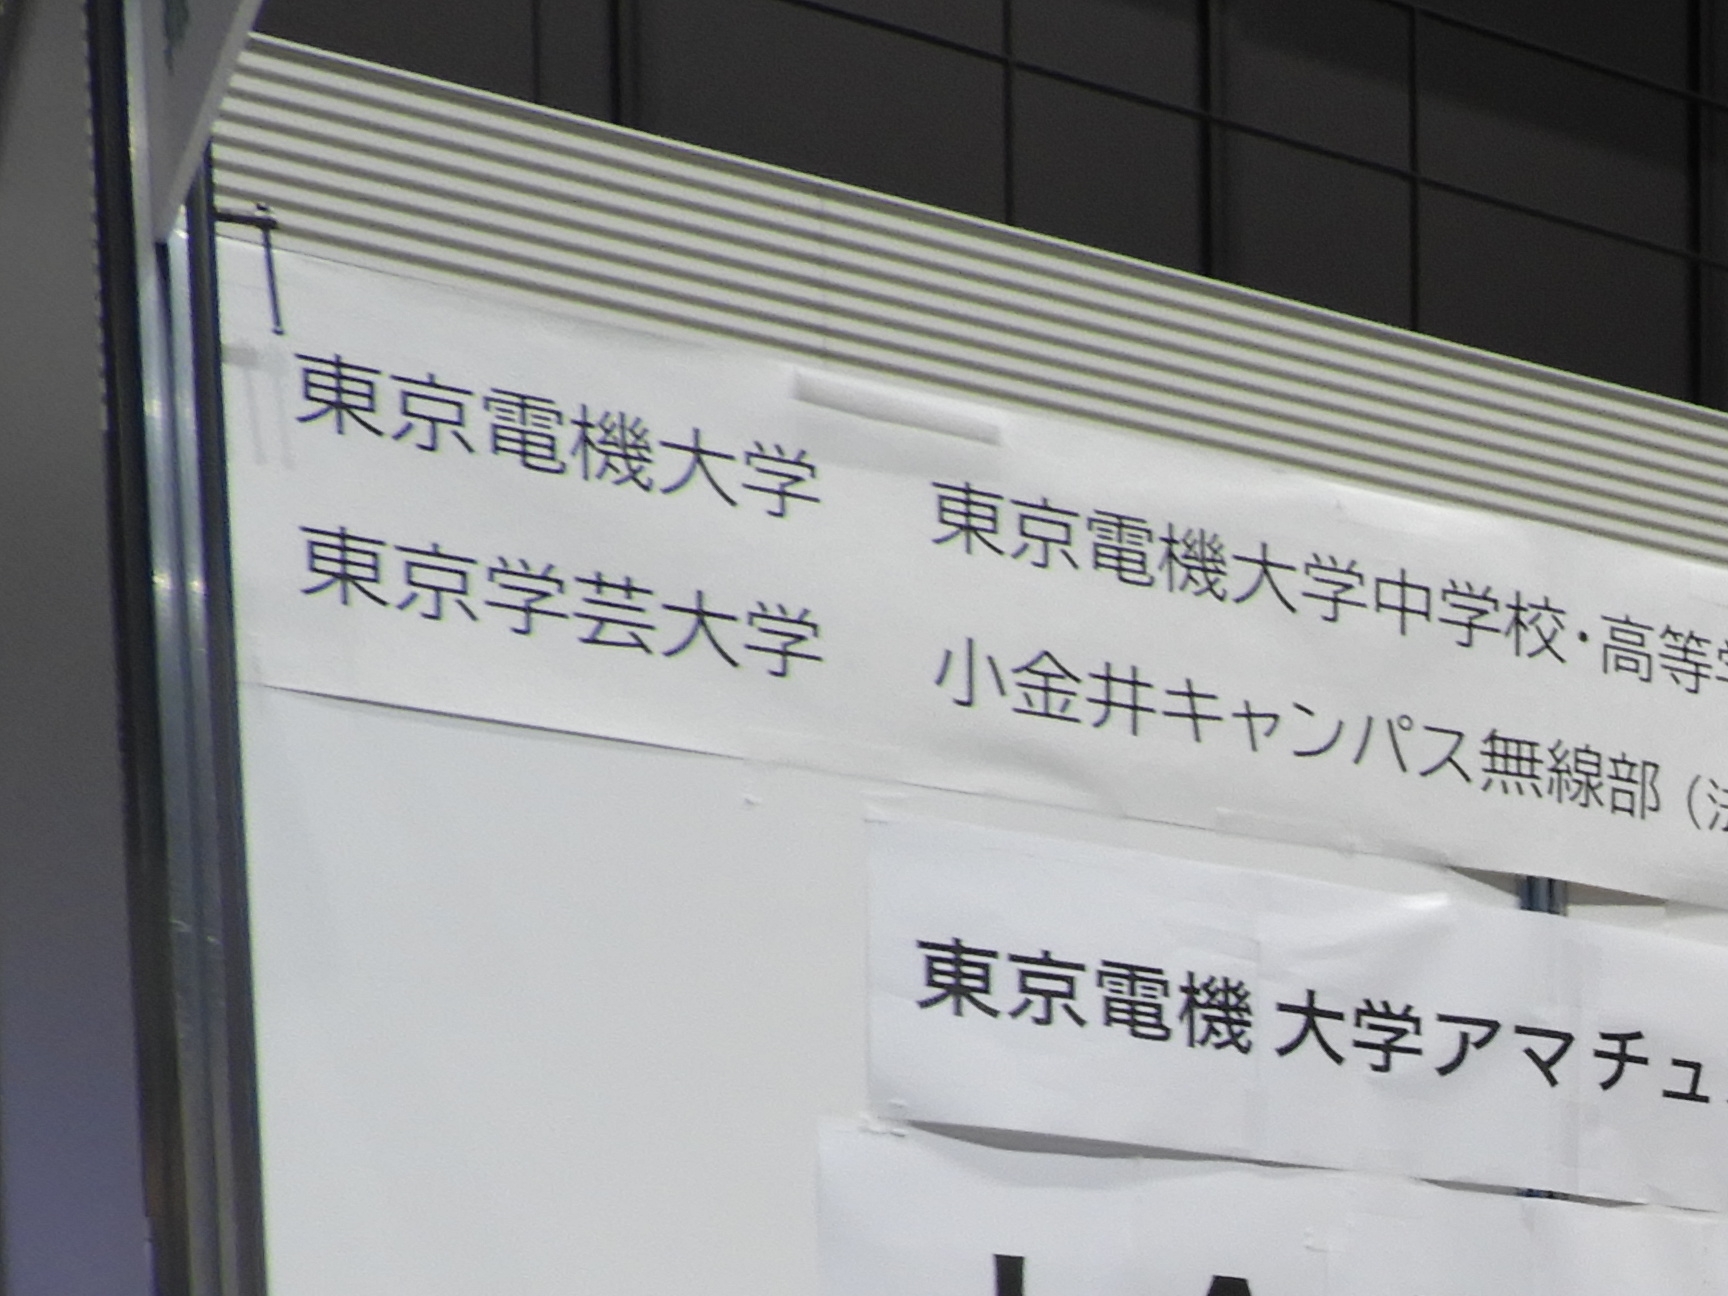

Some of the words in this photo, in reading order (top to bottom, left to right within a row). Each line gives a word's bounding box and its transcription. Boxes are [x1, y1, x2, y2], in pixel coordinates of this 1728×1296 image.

[294, 351, 822, 520] 東京電機大学
[299, 522, 824, 679] 東京学芸大学
